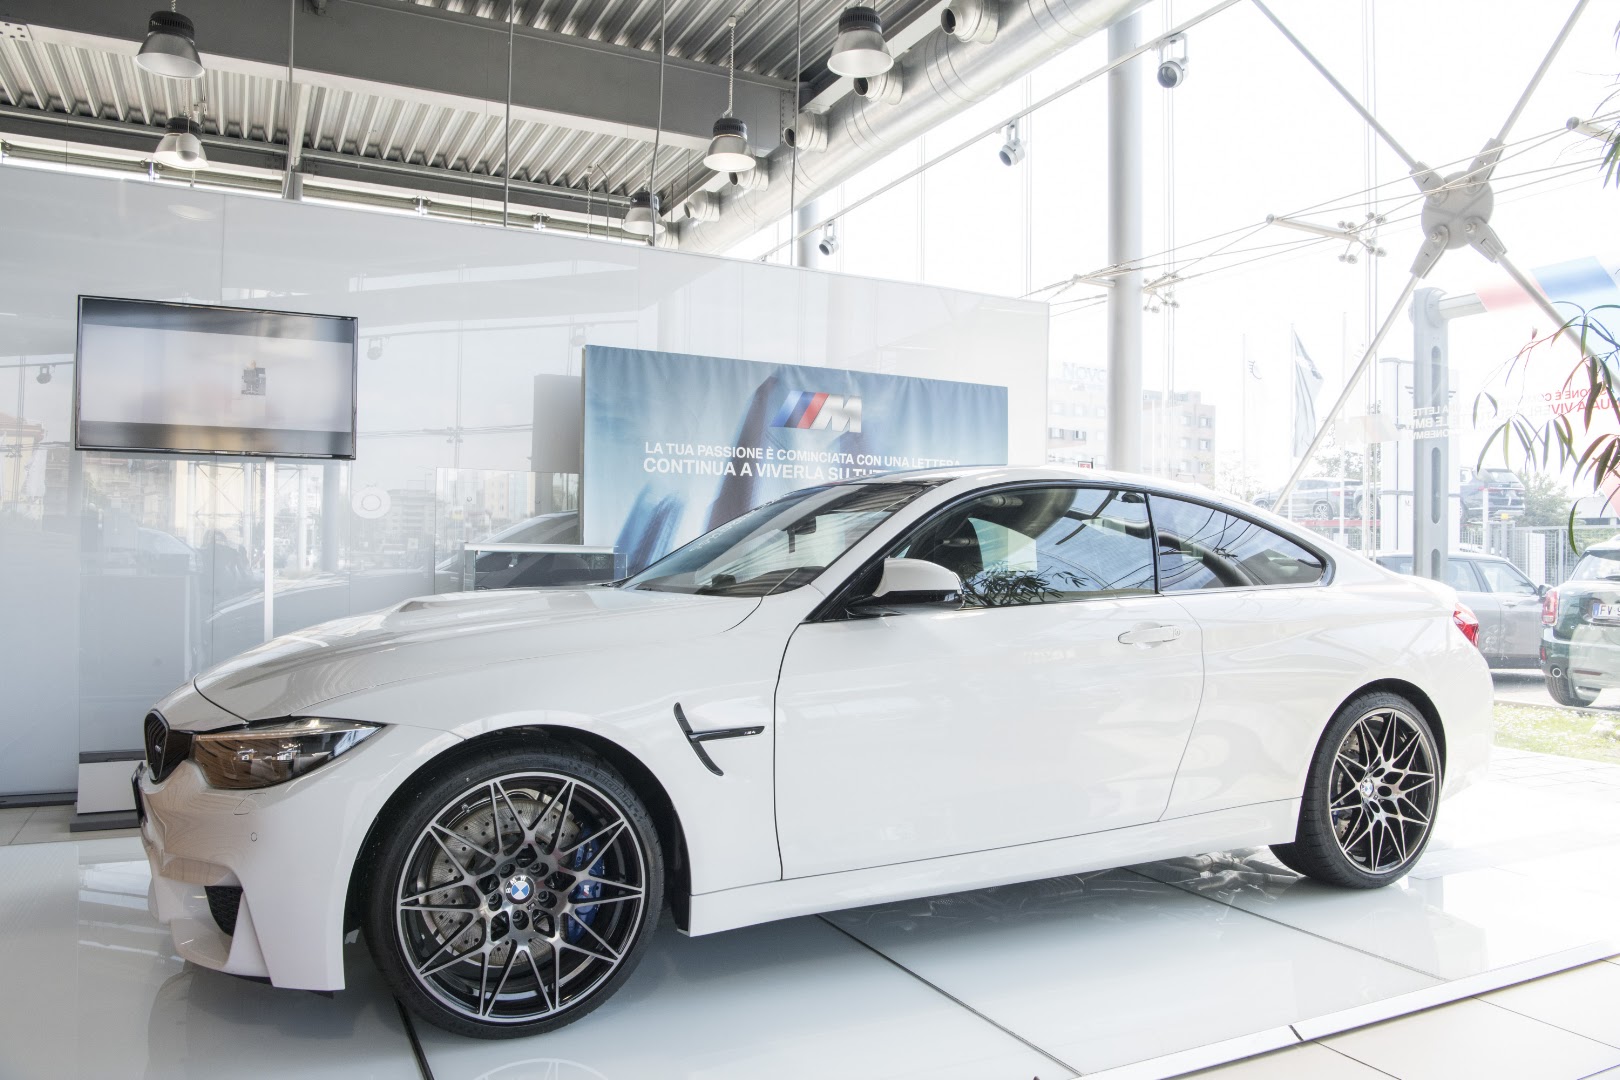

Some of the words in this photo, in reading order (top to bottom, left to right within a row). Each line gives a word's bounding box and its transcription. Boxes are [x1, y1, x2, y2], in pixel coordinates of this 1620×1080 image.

[645, 442, 663, 455] LA
[666, 443, 695, 456] TUA
[697, 445, 764, 459] PASSIONE
[766, 446, 774, 460] È
[777, 449, 855, 465] COMINCIATA
[857, 454, 882, 467] CON
[884, 456, 909, 467] UNA
[643, 457, 737, 476] CONTINUA
[740, 462, 753, 477] A
[755, 463, 825, 481] VIVERLA
